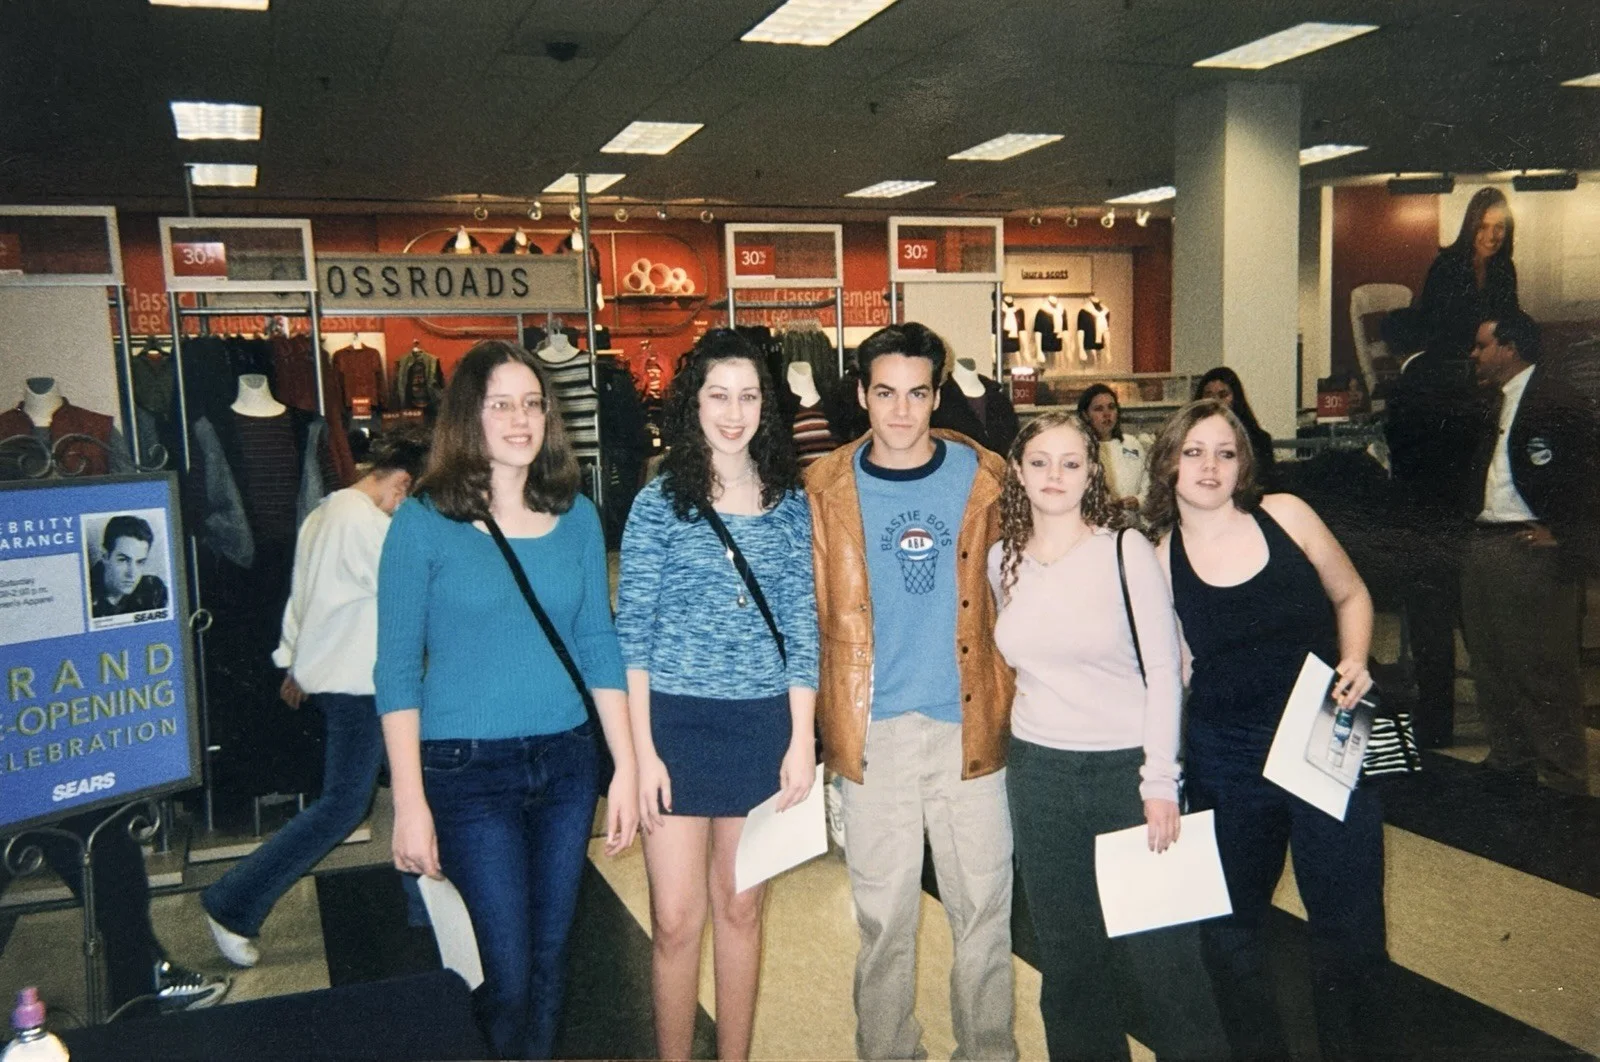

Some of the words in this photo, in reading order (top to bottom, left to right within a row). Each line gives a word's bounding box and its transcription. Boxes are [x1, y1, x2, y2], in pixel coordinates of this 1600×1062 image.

[1021, 268, 1043, 280] laura
[1046, 269, 1069, 280] scott
[881, 510, 921, 552] BEASTIE
[926, 512, 953, 548] BOYS
[907, 538, 925, 549] ABA
[134, 609, 168, 624] SEARS
[7, 642, 175, 702] RAND
[0, 717, 178, 775] LEBRATION
[52, 771, 116, 803] SEARS
